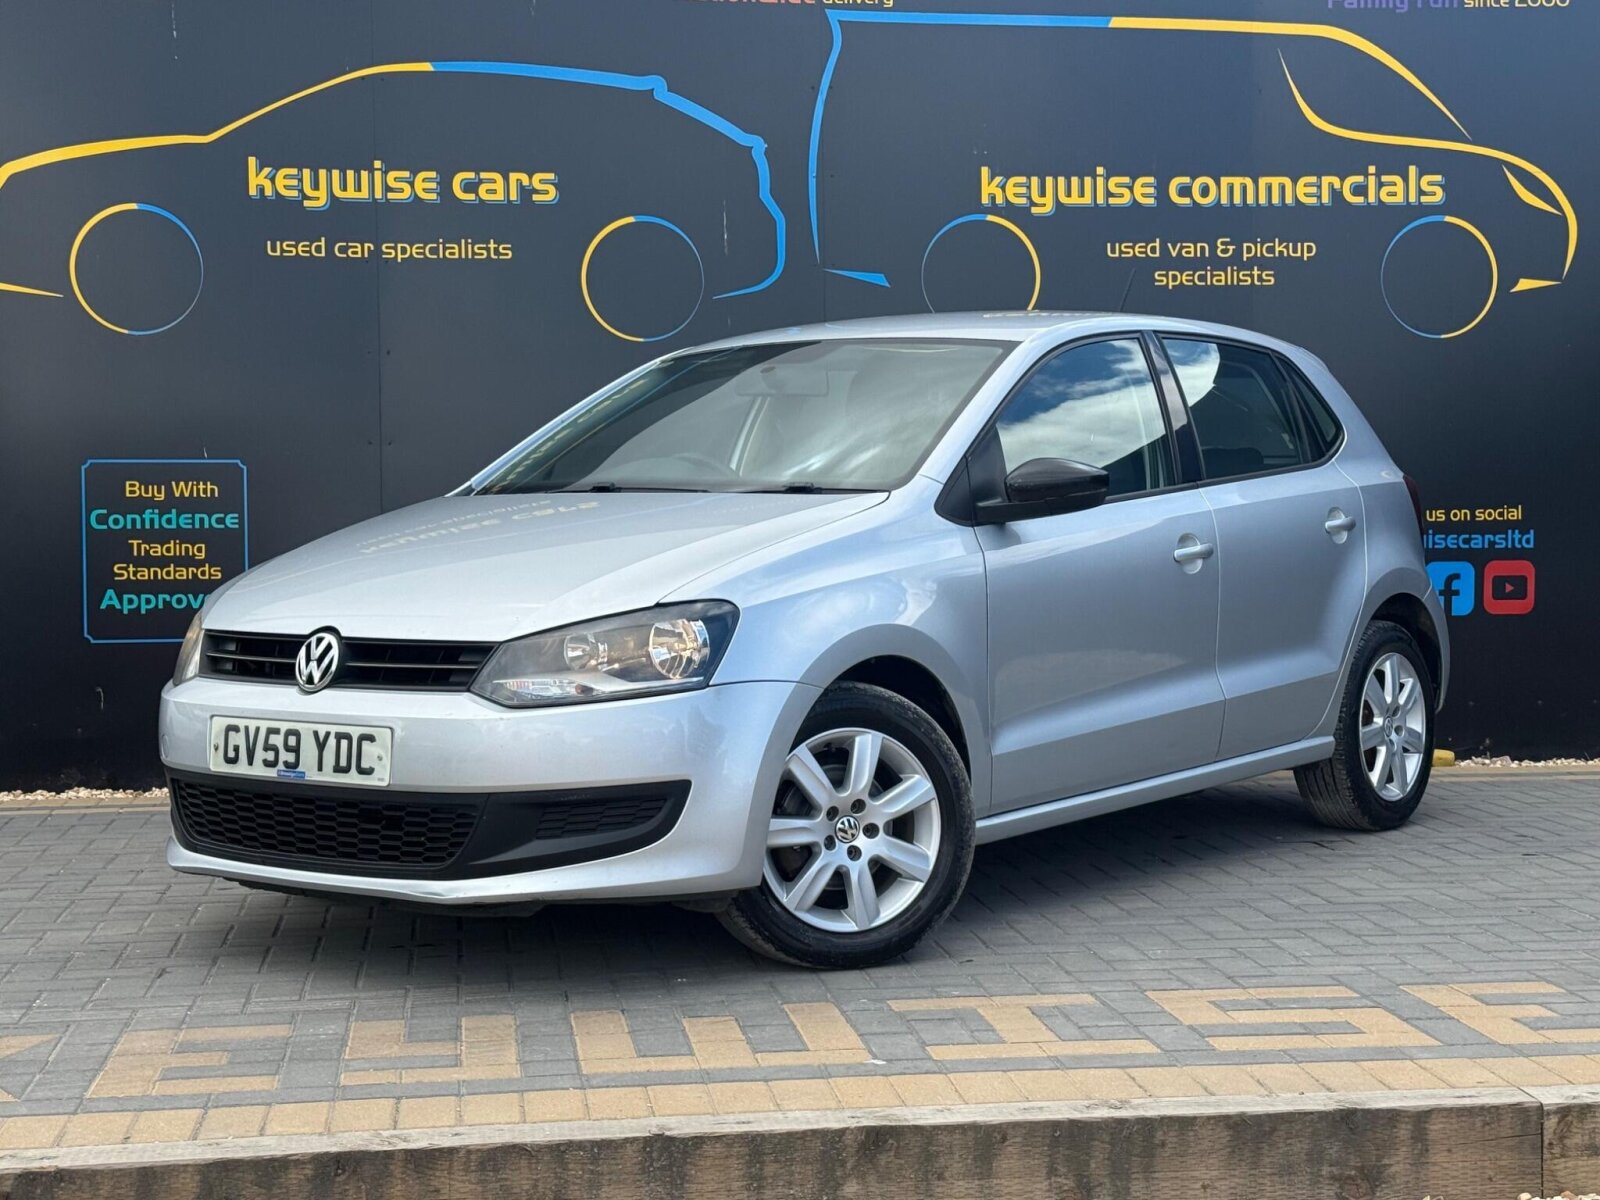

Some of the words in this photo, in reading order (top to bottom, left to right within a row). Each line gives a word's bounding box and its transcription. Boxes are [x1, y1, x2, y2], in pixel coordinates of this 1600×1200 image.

[247, 156, 440, 211] keywise
[452, 171, 559, 204] cars
[980, 165, 1157, 216] keywise
[1168, 164, 1446, 207] commercials
[266, 237, 326, 257] used
[334, 242, 375, 258] car
[381, 238, 513, 262] specialists
[1106, 238, 1160, 258] used
[1168, 242, 1209, 258] van
[1216, 239, 1237, 258] &
[1242, 238, 1317, 261] pickup
[1153, 265, 1276, 286] specialists
[125, 480, 165, 501] Buy
[171, 481, 219, 498] With
[89, 508, 240, 530] Confidence
[1426, 509, 1446, 521] us
[1450, 508, 1471, 521] on
[1475, 505, 1522, 521] social
[128, 540, 206, 559] Trading
[1424, 529, 1534, 549] isecarsltd
[113, 563, 222, 581] Standards
[223, 723, 302, 771] GV59
[312, 730, 377, 777] YDC
